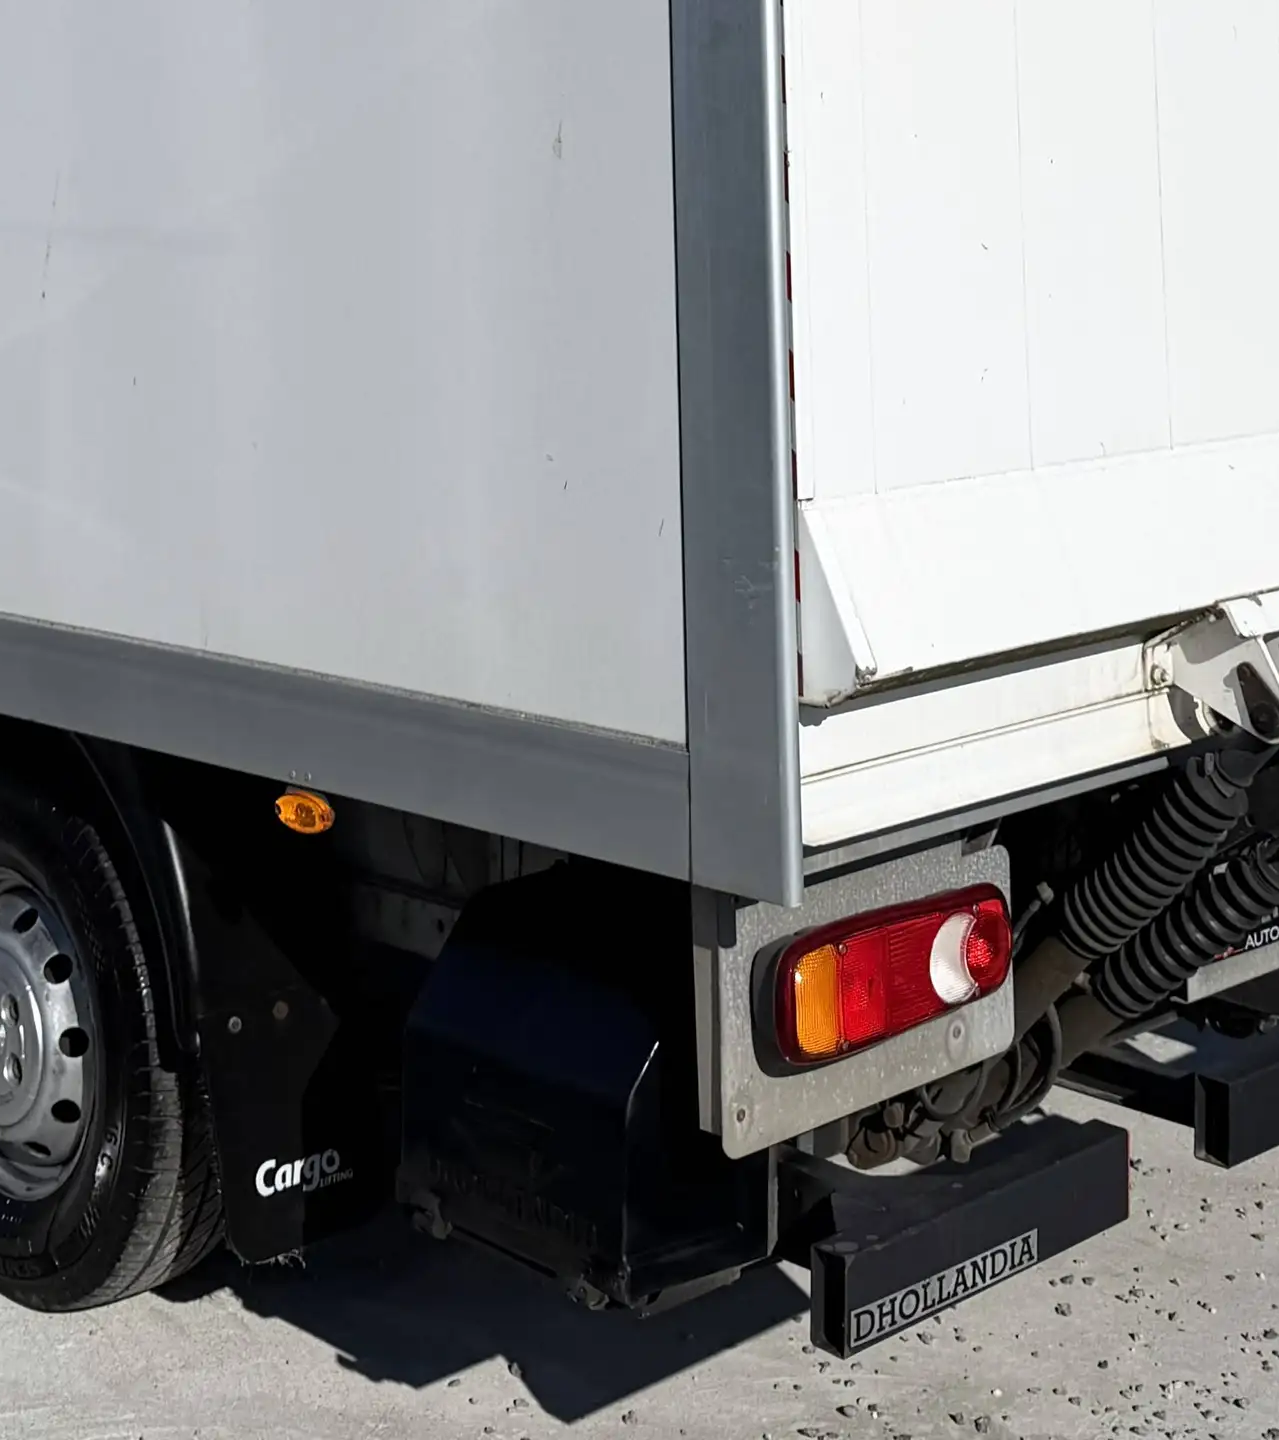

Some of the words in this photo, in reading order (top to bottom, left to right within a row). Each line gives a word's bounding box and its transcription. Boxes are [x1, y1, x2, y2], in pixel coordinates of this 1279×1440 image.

[1245, 924, 1279, 950] AUTO
[255, 1148, 340, 1197] Cargo
[853, 1234, 1036, 1343] DHOLLANDIA
